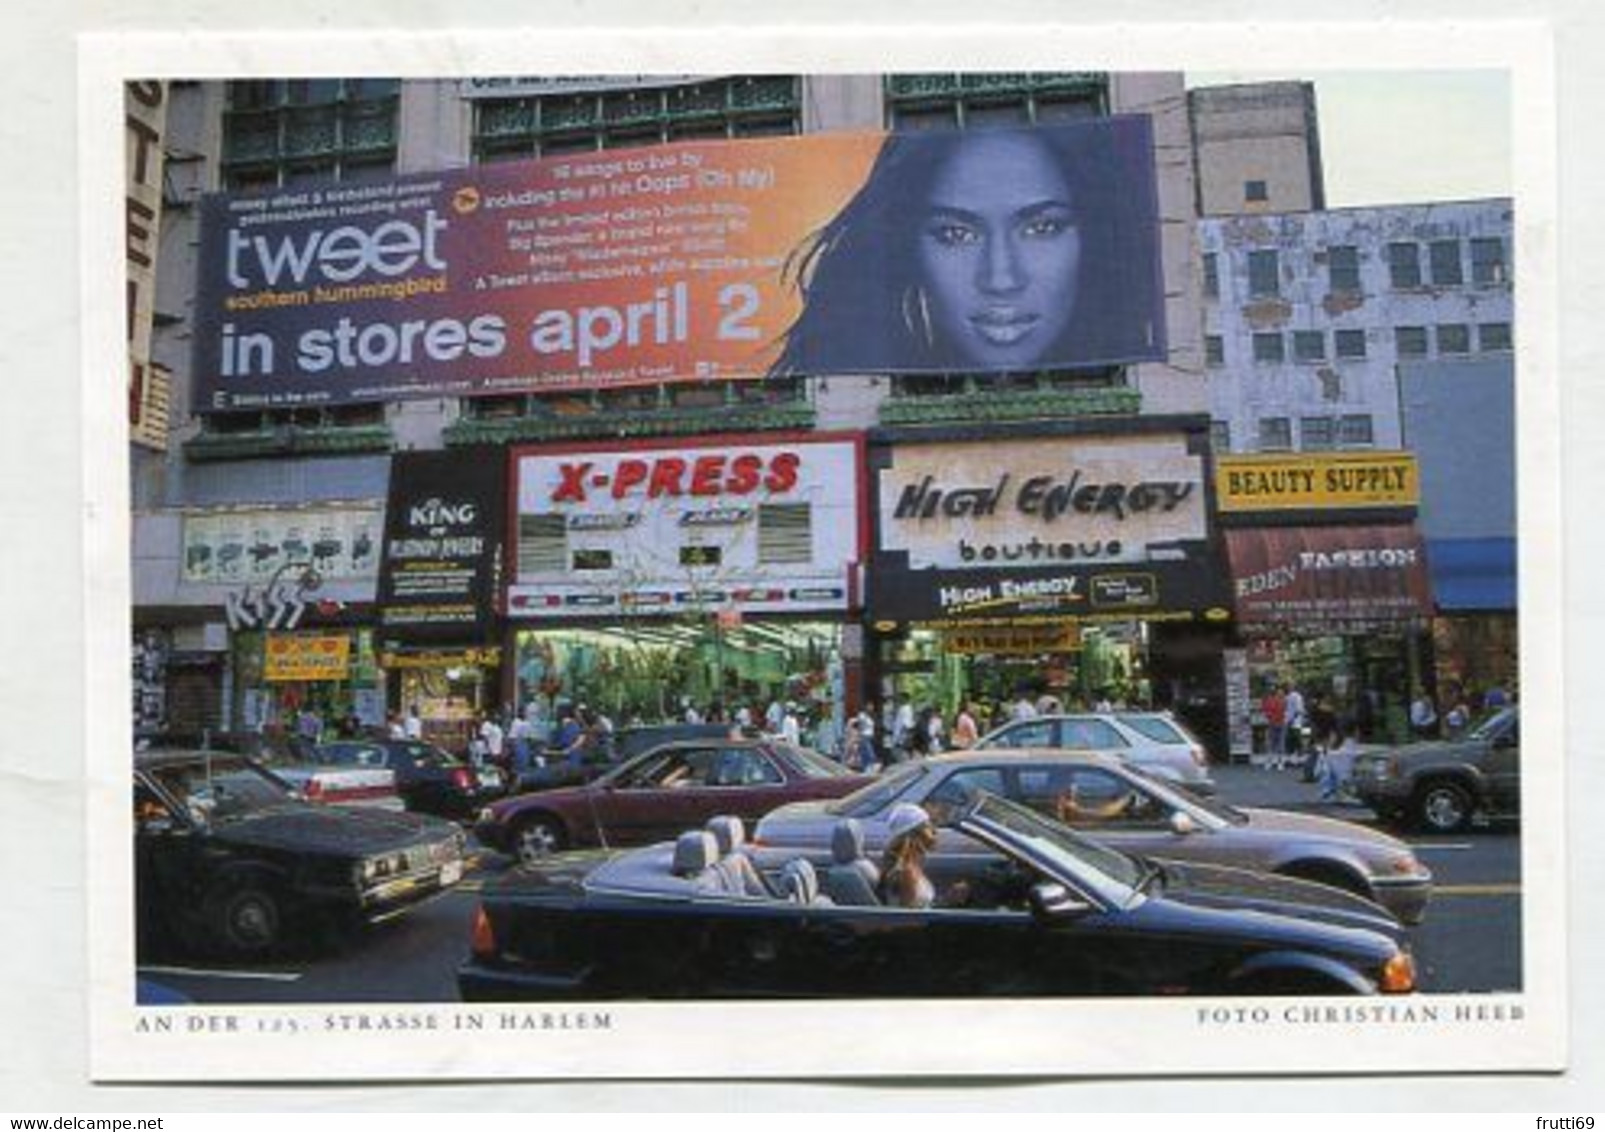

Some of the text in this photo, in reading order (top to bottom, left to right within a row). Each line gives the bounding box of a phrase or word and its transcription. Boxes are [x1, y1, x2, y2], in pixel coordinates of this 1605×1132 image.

[484, 188, 556, 208] including
[636, 173, 691, 195] Oops
[228, 209, 448, 288] tweet
[226, 275, 447, 311] southern hummingbird
[220, 280, 762, 377] in stores april 2
[553, 451, 801, 502] X-PRESS
[1228, 465, 1408, 496] BEAUTY SUPPLY
[135, 1017, 173, 1033] AN
[187, 1016, 240, 1032] DER
[323, 1014, 438, 1031] STRASSE
[453, 1014, 484, 1030] IN
[499, 1013, 613, 1030] HARLEM
[1197, 1008, 1270, 1025] FOTO
[1283, 1006, 1440, 1024] CHRISTIAN
